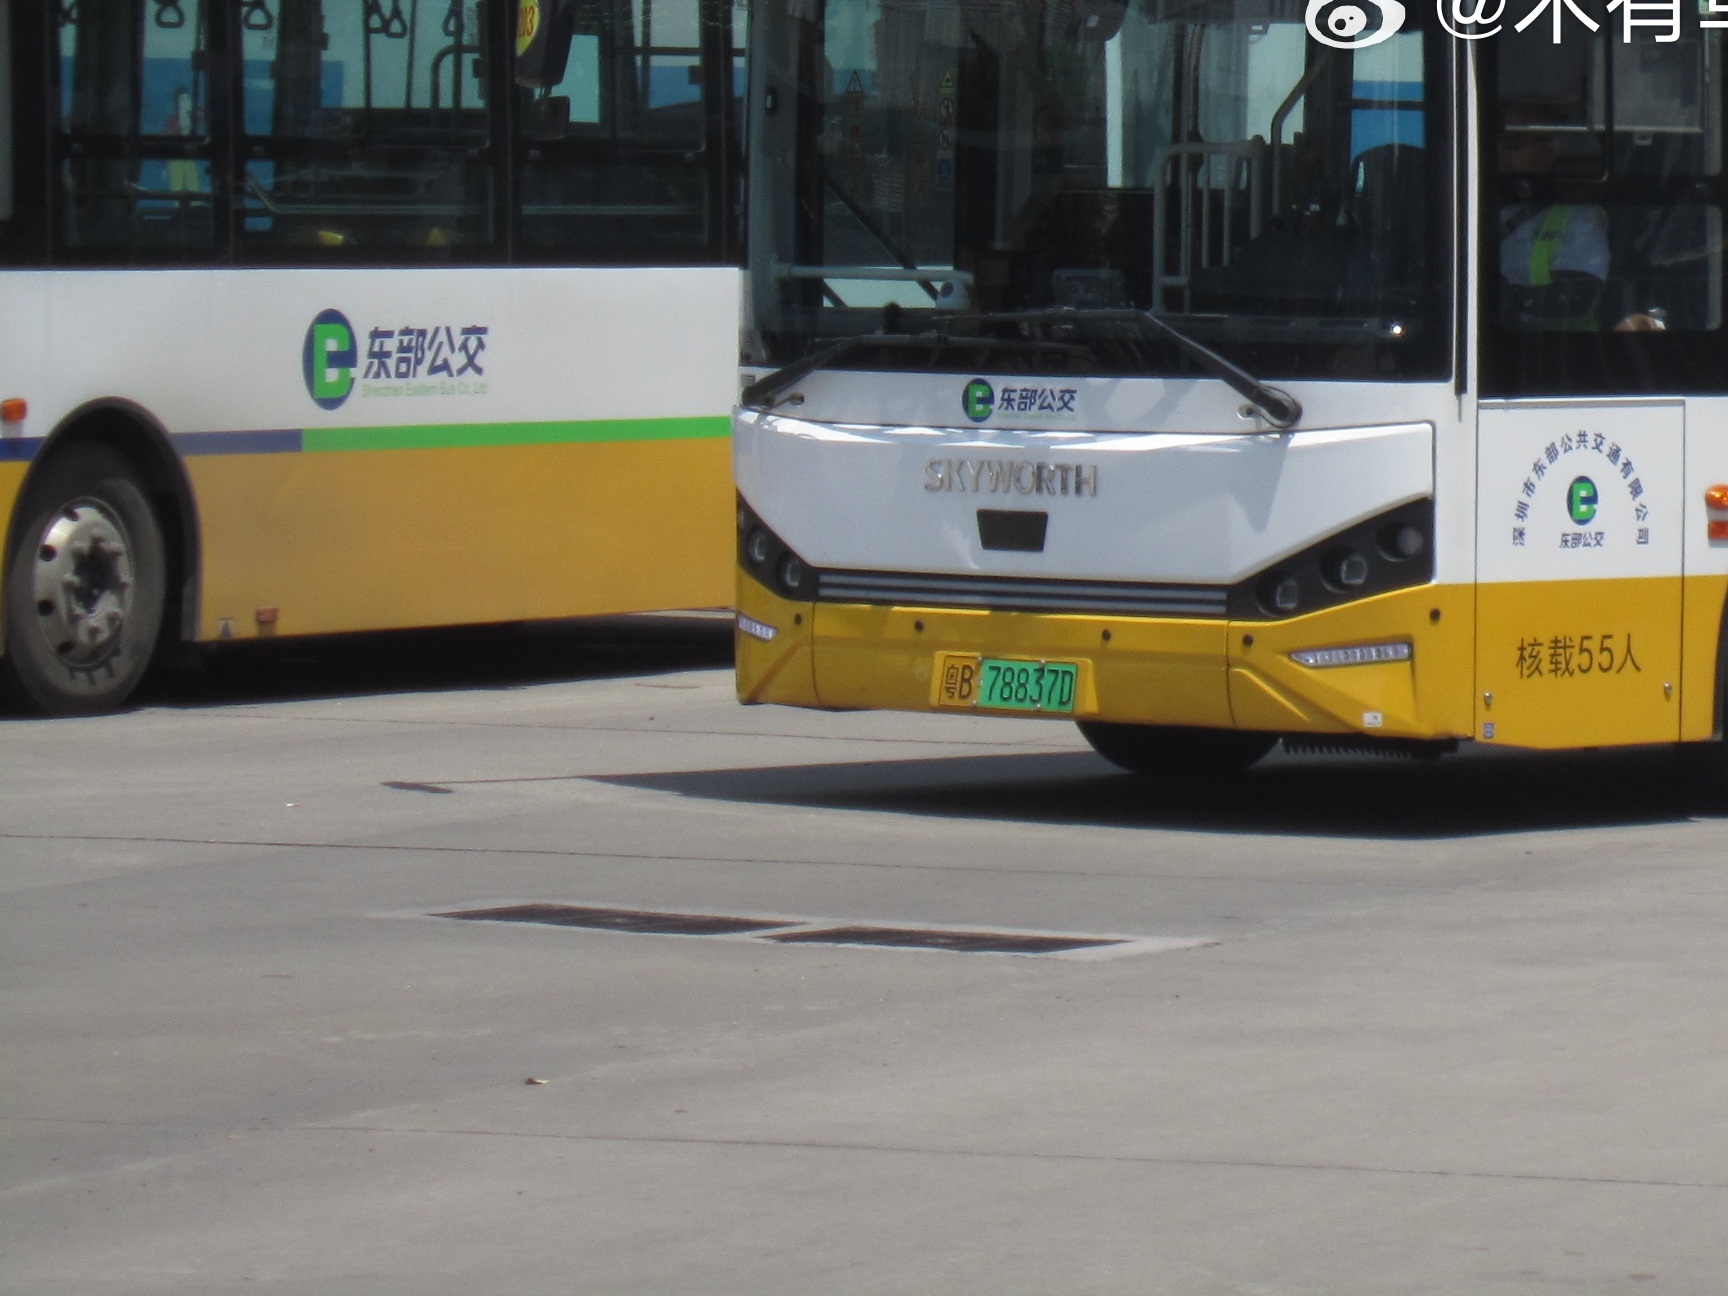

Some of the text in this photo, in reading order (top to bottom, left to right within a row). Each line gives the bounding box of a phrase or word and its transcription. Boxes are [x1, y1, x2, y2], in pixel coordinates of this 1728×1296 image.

[362, 325, 488, 379] 东部公交
[998, 387, 1077, 412] 东部公交
[924, 459, 1098, 497] SKYWORTH
[1512, 430, 1649, 547] 深圳市东部公共交通有限公司
[1559, 531, 1605, 549] 东部公交
[1516, 633, 1641, 680] 核载55人
